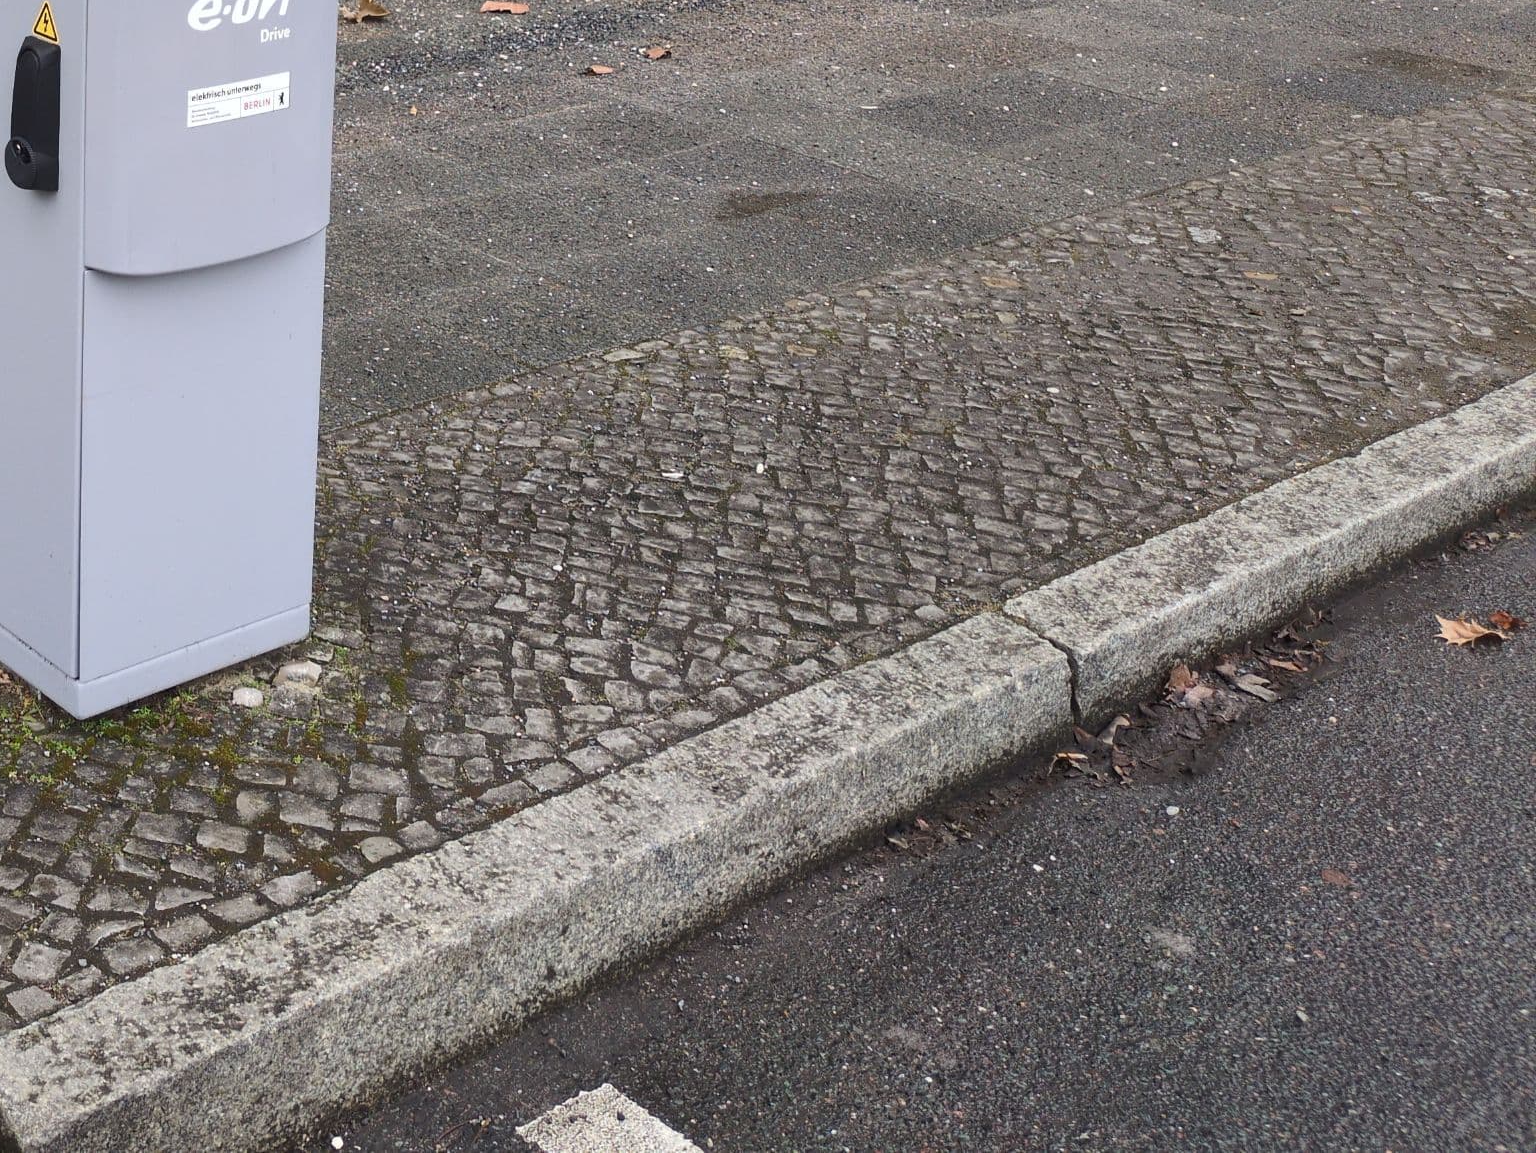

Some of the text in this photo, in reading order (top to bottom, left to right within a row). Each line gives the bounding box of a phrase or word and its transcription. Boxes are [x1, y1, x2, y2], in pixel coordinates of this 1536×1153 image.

[260, 26, 291, 44] Drive
[191, 82, 262, 102] elektrisch unterwegs
[243, 97, 271, 111] BERLIN
